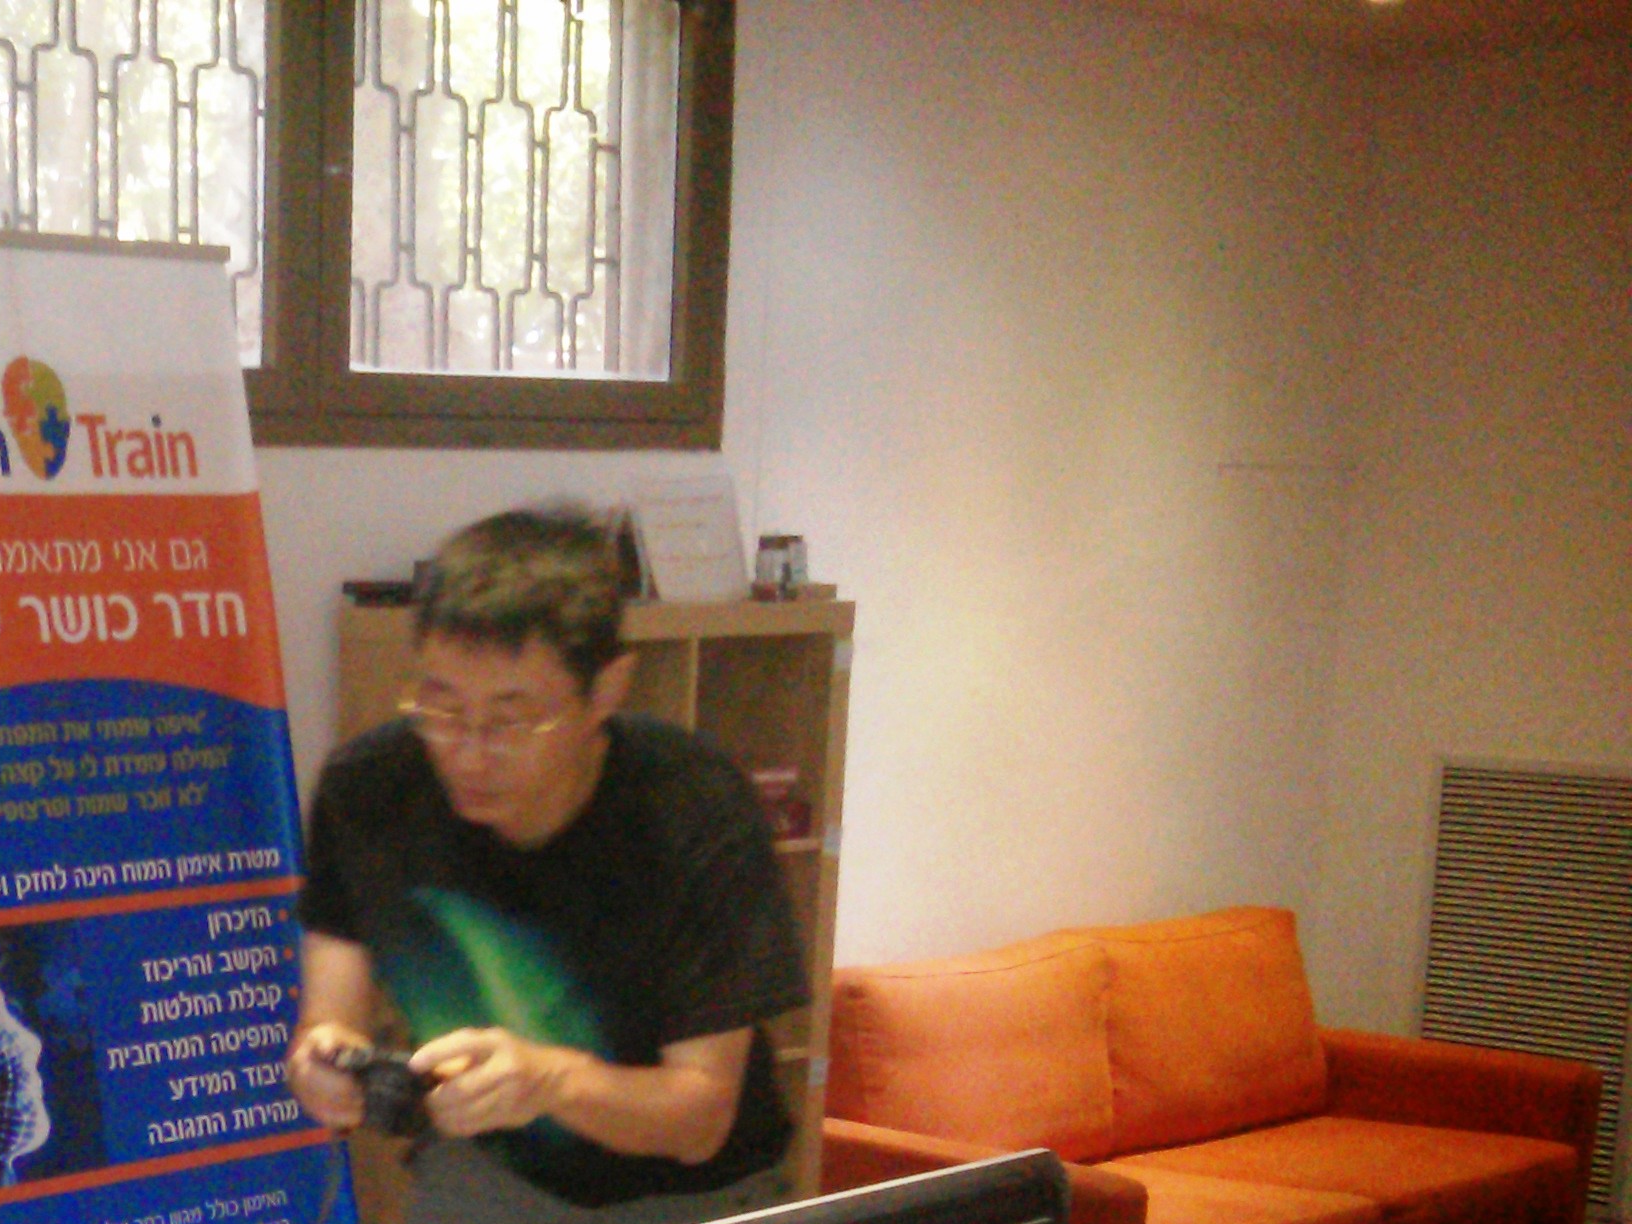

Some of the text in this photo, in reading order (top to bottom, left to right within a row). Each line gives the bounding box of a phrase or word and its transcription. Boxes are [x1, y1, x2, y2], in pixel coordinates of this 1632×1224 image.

[77, 413, 198, 478] Train
[112, 541, 158, 571] אני
[171, 539, 208, 571] גם
[18, 594, 138, 644] כושר
[153, 592, 247, 640] חדר
[63, 720, 90, 742] את
[1, 760, 44, 787] קצה
[48, 754, 75, 780] על
[79, 753, 98, 778] לי
[121, 859, 170, 883] המוח
[177, 854, 222, 882] אימון
[226, 848, 280, 869] מטרת
[15, 864, 67, 899] לחזק
[74, 864, 116, 888] הינה
[208, 906, 272, 940] הזיכרון
[142, 946, 277, 982] הקשב והריכוז
[141, 983, 282, 1024] קבלת החלטות
[107, 1023, 288, 1070] התפיסה המרחבית
[169, 1069, 236, 1101] המידע
[148, 1099, 299, 1145] מהירות התגובה
[205, 1200, 239, 1220] כולל
[243, 1190, 288, 1217] האימון
